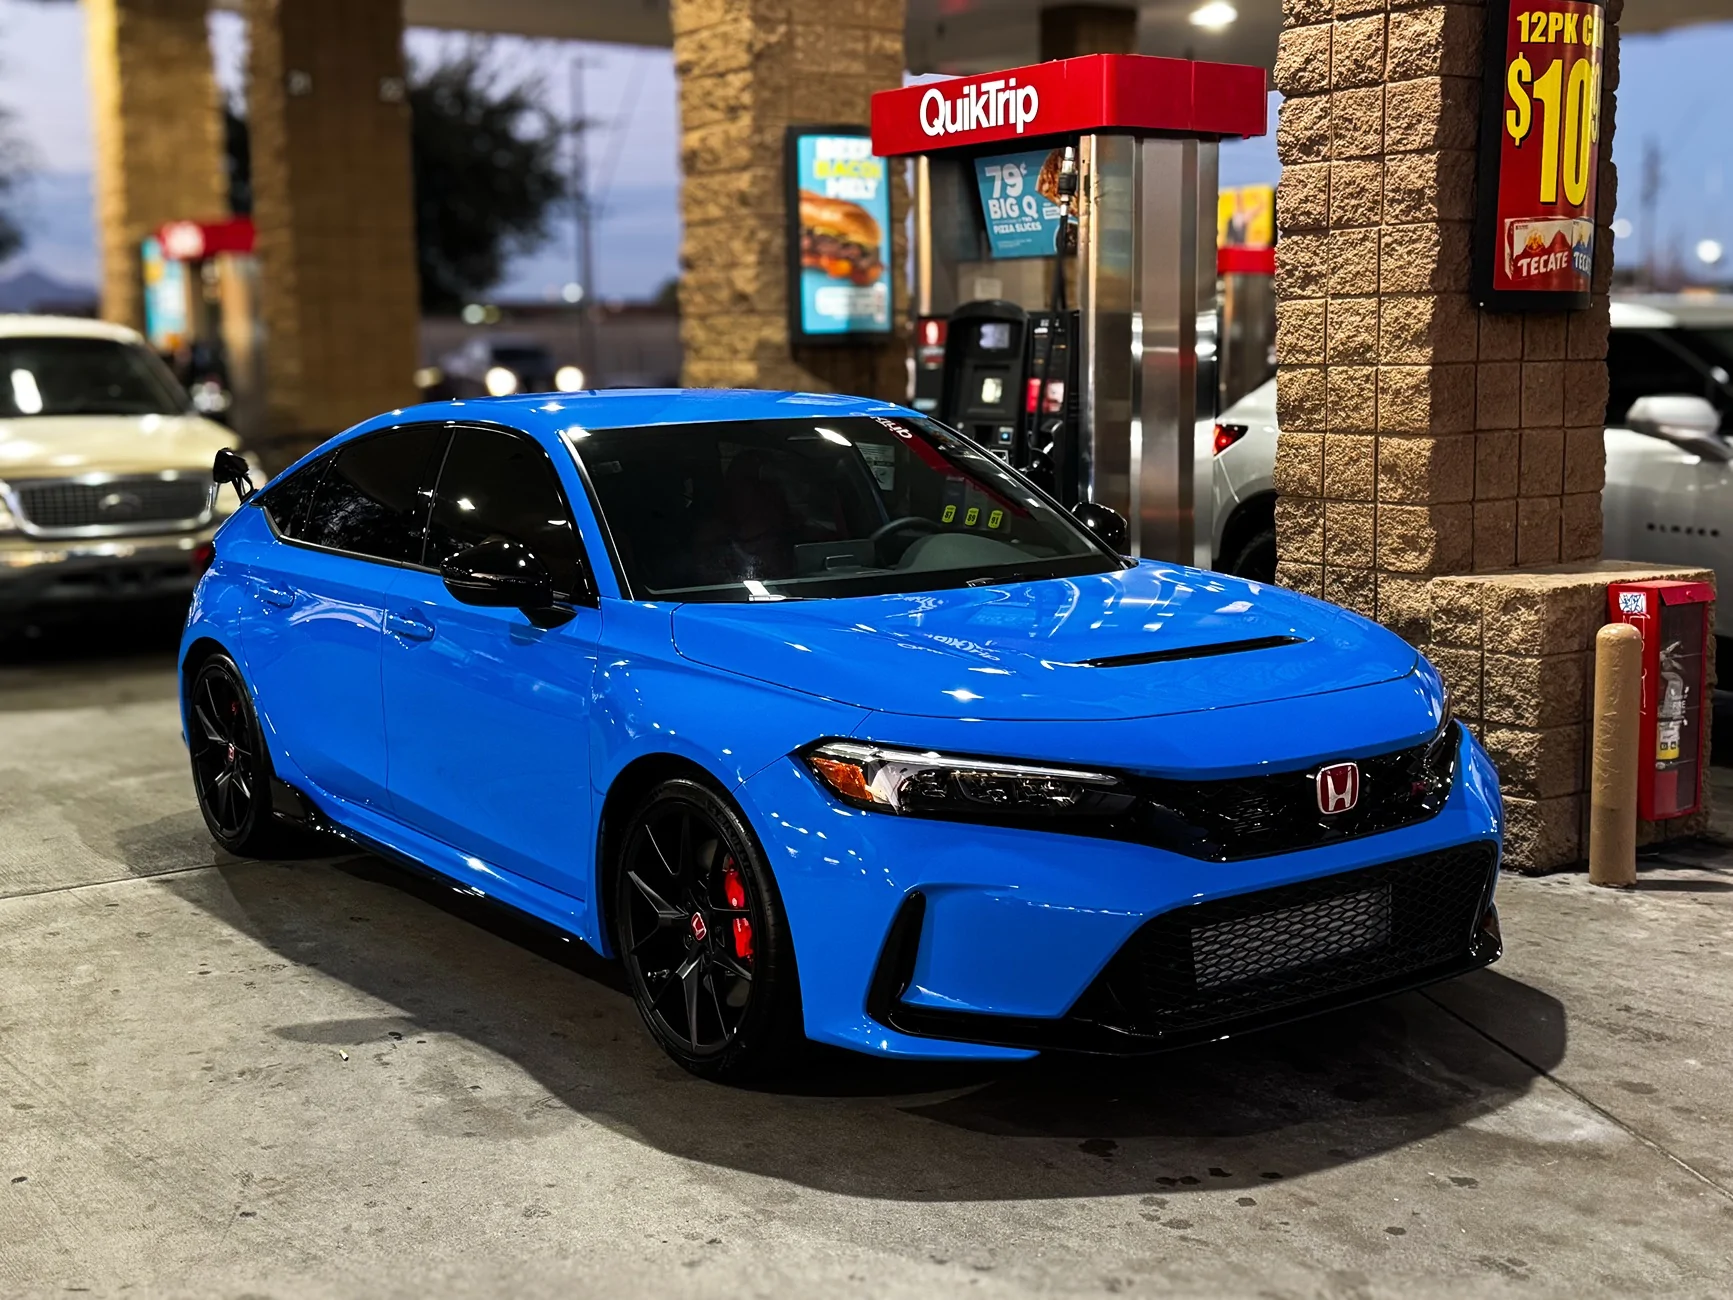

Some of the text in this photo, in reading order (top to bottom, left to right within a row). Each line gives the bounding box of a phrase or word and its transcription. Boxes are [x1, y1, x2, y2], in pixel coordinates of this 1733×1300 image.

[1516, 11, 1579, 44] 12PK
[919, 76, 1039, 136] QuikTrip
[988, 196, 1020, 220] BIG
[1022, 195, 1039, 219] Q
[993, 223, 1015, 235] PIZZA
[1015, 221, 1042, 233] SLICES
[1517, 251, 1569, 277] TECATE
